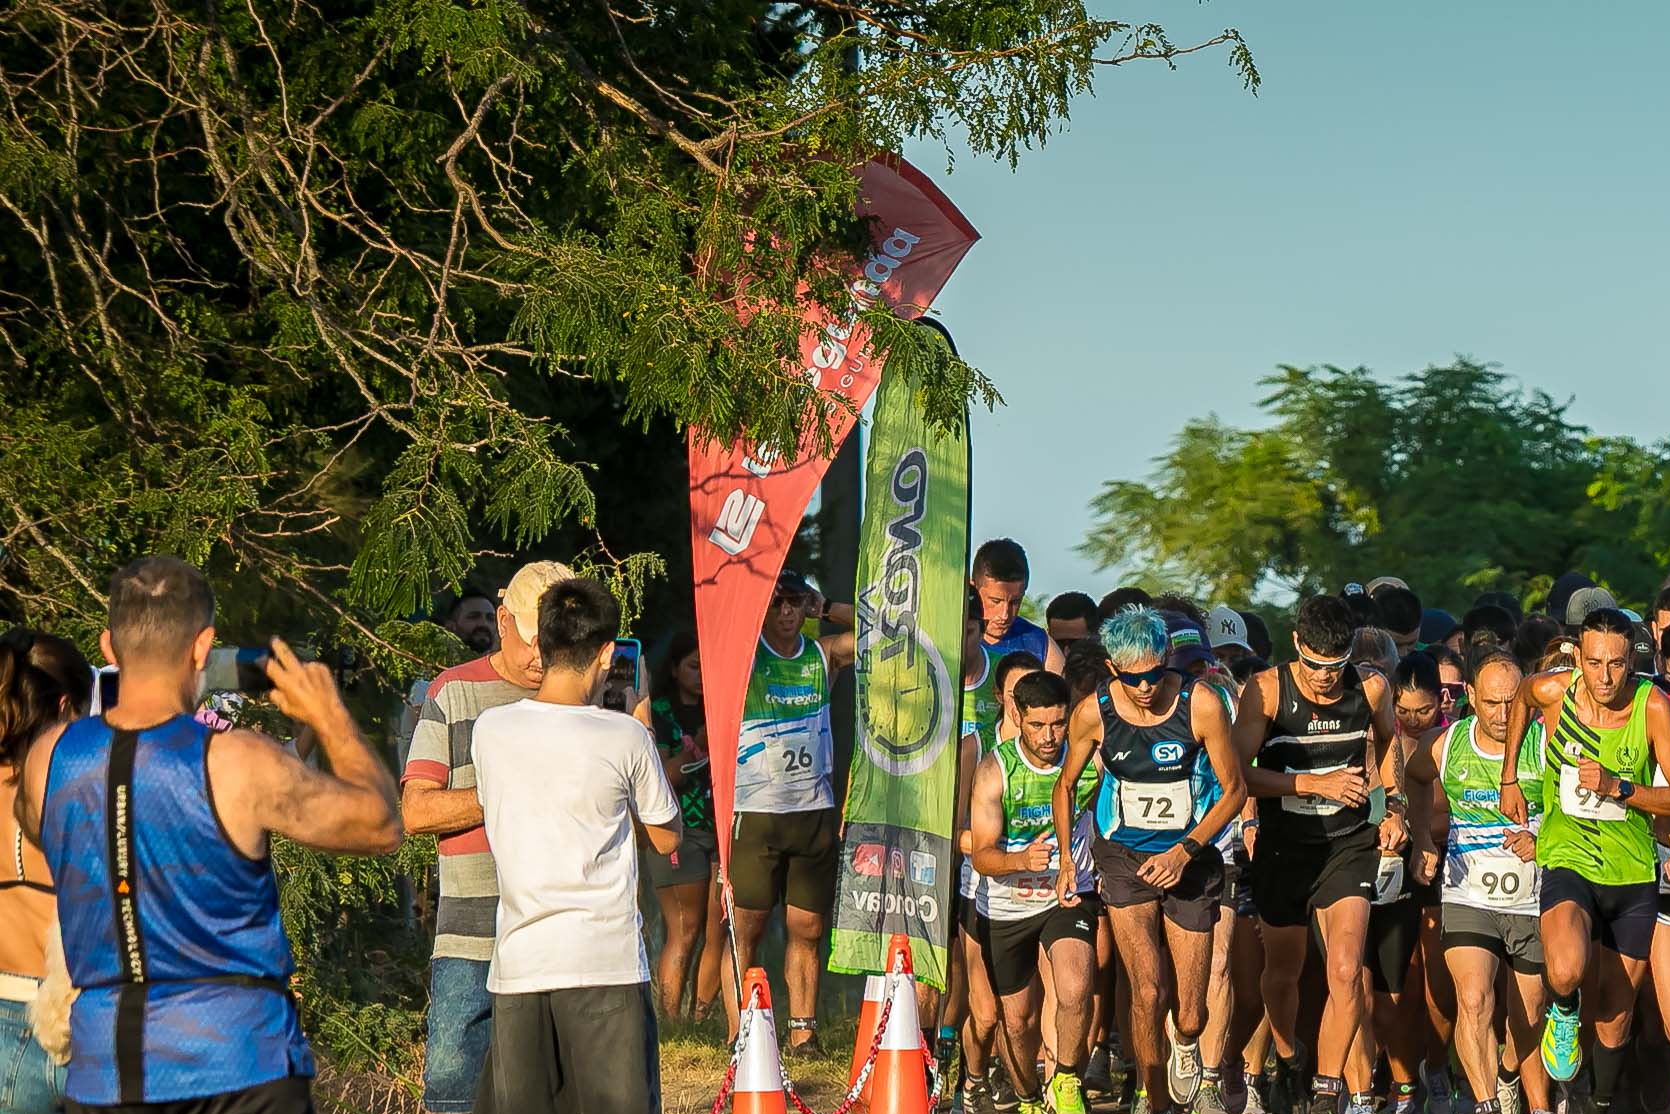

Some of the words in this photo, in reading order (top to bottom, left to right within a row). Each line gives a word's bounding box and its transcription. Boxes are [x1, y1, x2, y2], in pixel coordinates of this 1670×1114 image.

[1308, 719, 1341, 731] ATENAS
[782, 746, 813, 773] 26
[1138, 796, 1175, 819] 72
[1016, 875, 1053, 899] 53
[1379, 871, 1396, 894] 7
[1481, 872, 1520, 895] 90
